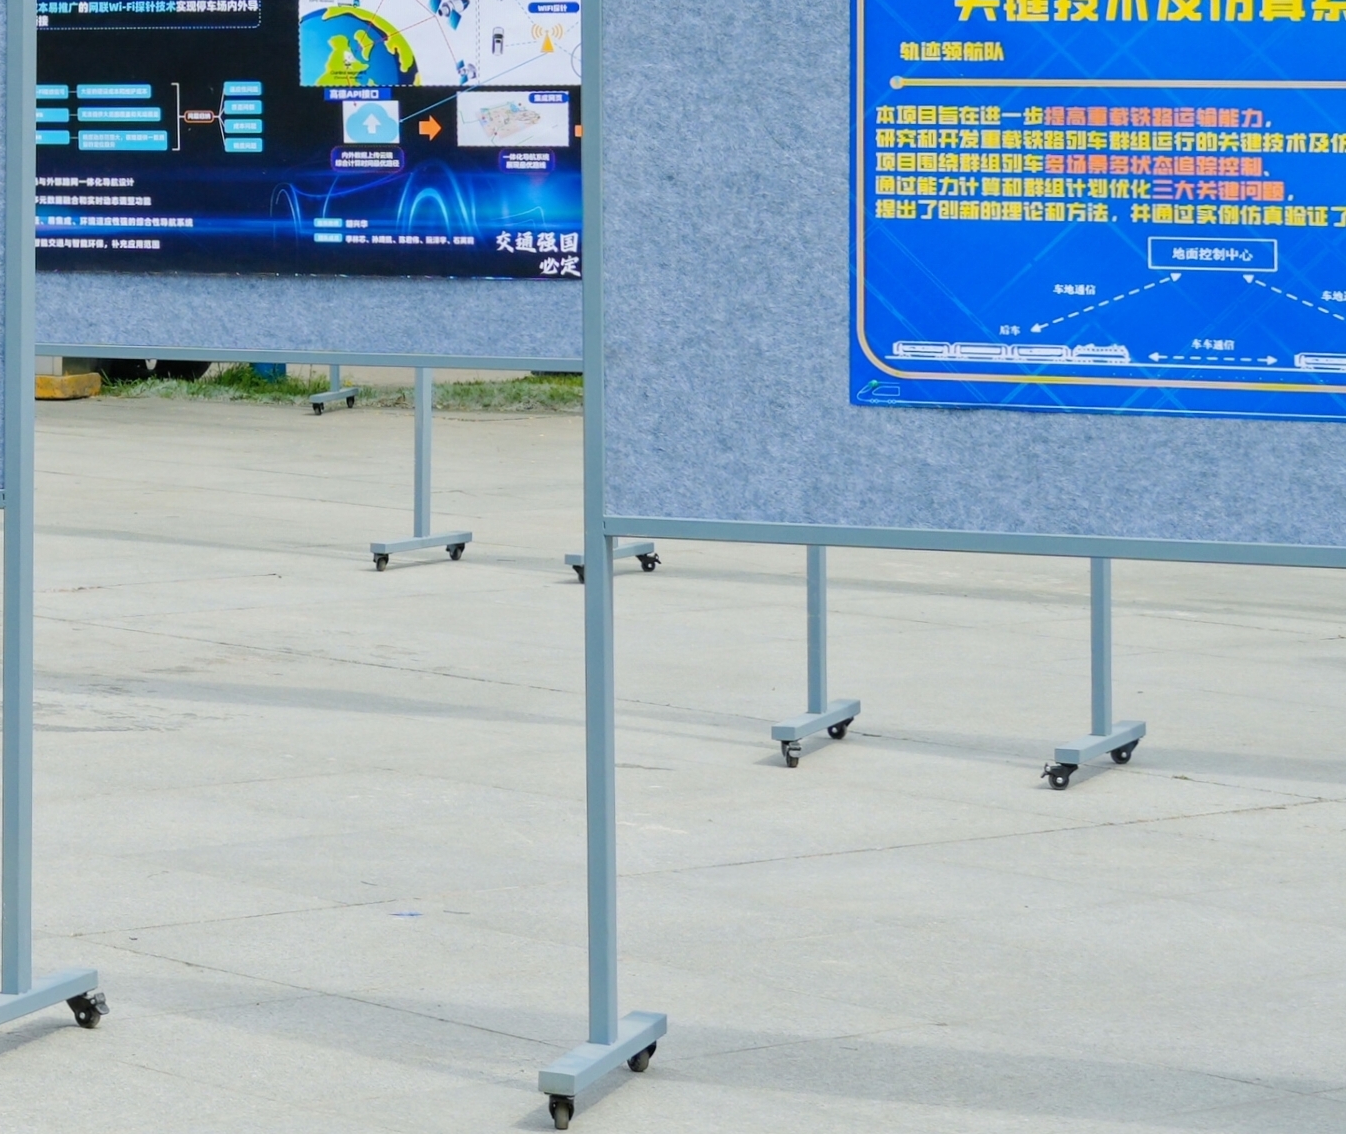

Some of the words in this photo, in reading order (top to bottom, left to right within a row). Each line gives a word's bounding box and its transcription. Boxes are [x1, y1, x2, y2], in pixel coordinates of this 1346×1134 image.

[36, 0, 258, 14] 本易推广的网联Wi-Fi探针技术实现停车场内外导
[899, 41, 1004, 62] 轨迹领航队
[329, 89, 379, 99] 高德API接口
[875, 105, 1272, 129] 本项目旨在进一步提高重载铁路运输能力，
[875, 152, 1271, 177] 项目围绕群组列车多场景多状态追踪控制、
[35, 177, 135, 187] 与外部路网一体化导航设计
[875, 176, 1295, 201] 通过能力计算和群组计划优化三大关键问题，
[875, 199, 1346, 227] 提出了创新的理论和方法，并通过实例仿真验证了
[496, 230, 579, 253] 交通强国
[1172, 247, 1254, 262] 地面控制中心
[539, 255, 581, 277] 必定
[1053, 283, 1096, 296] 车地通信
[999, 325, 1021, 336] 后车
[1191, 338, 1235, 351] 车车通信
